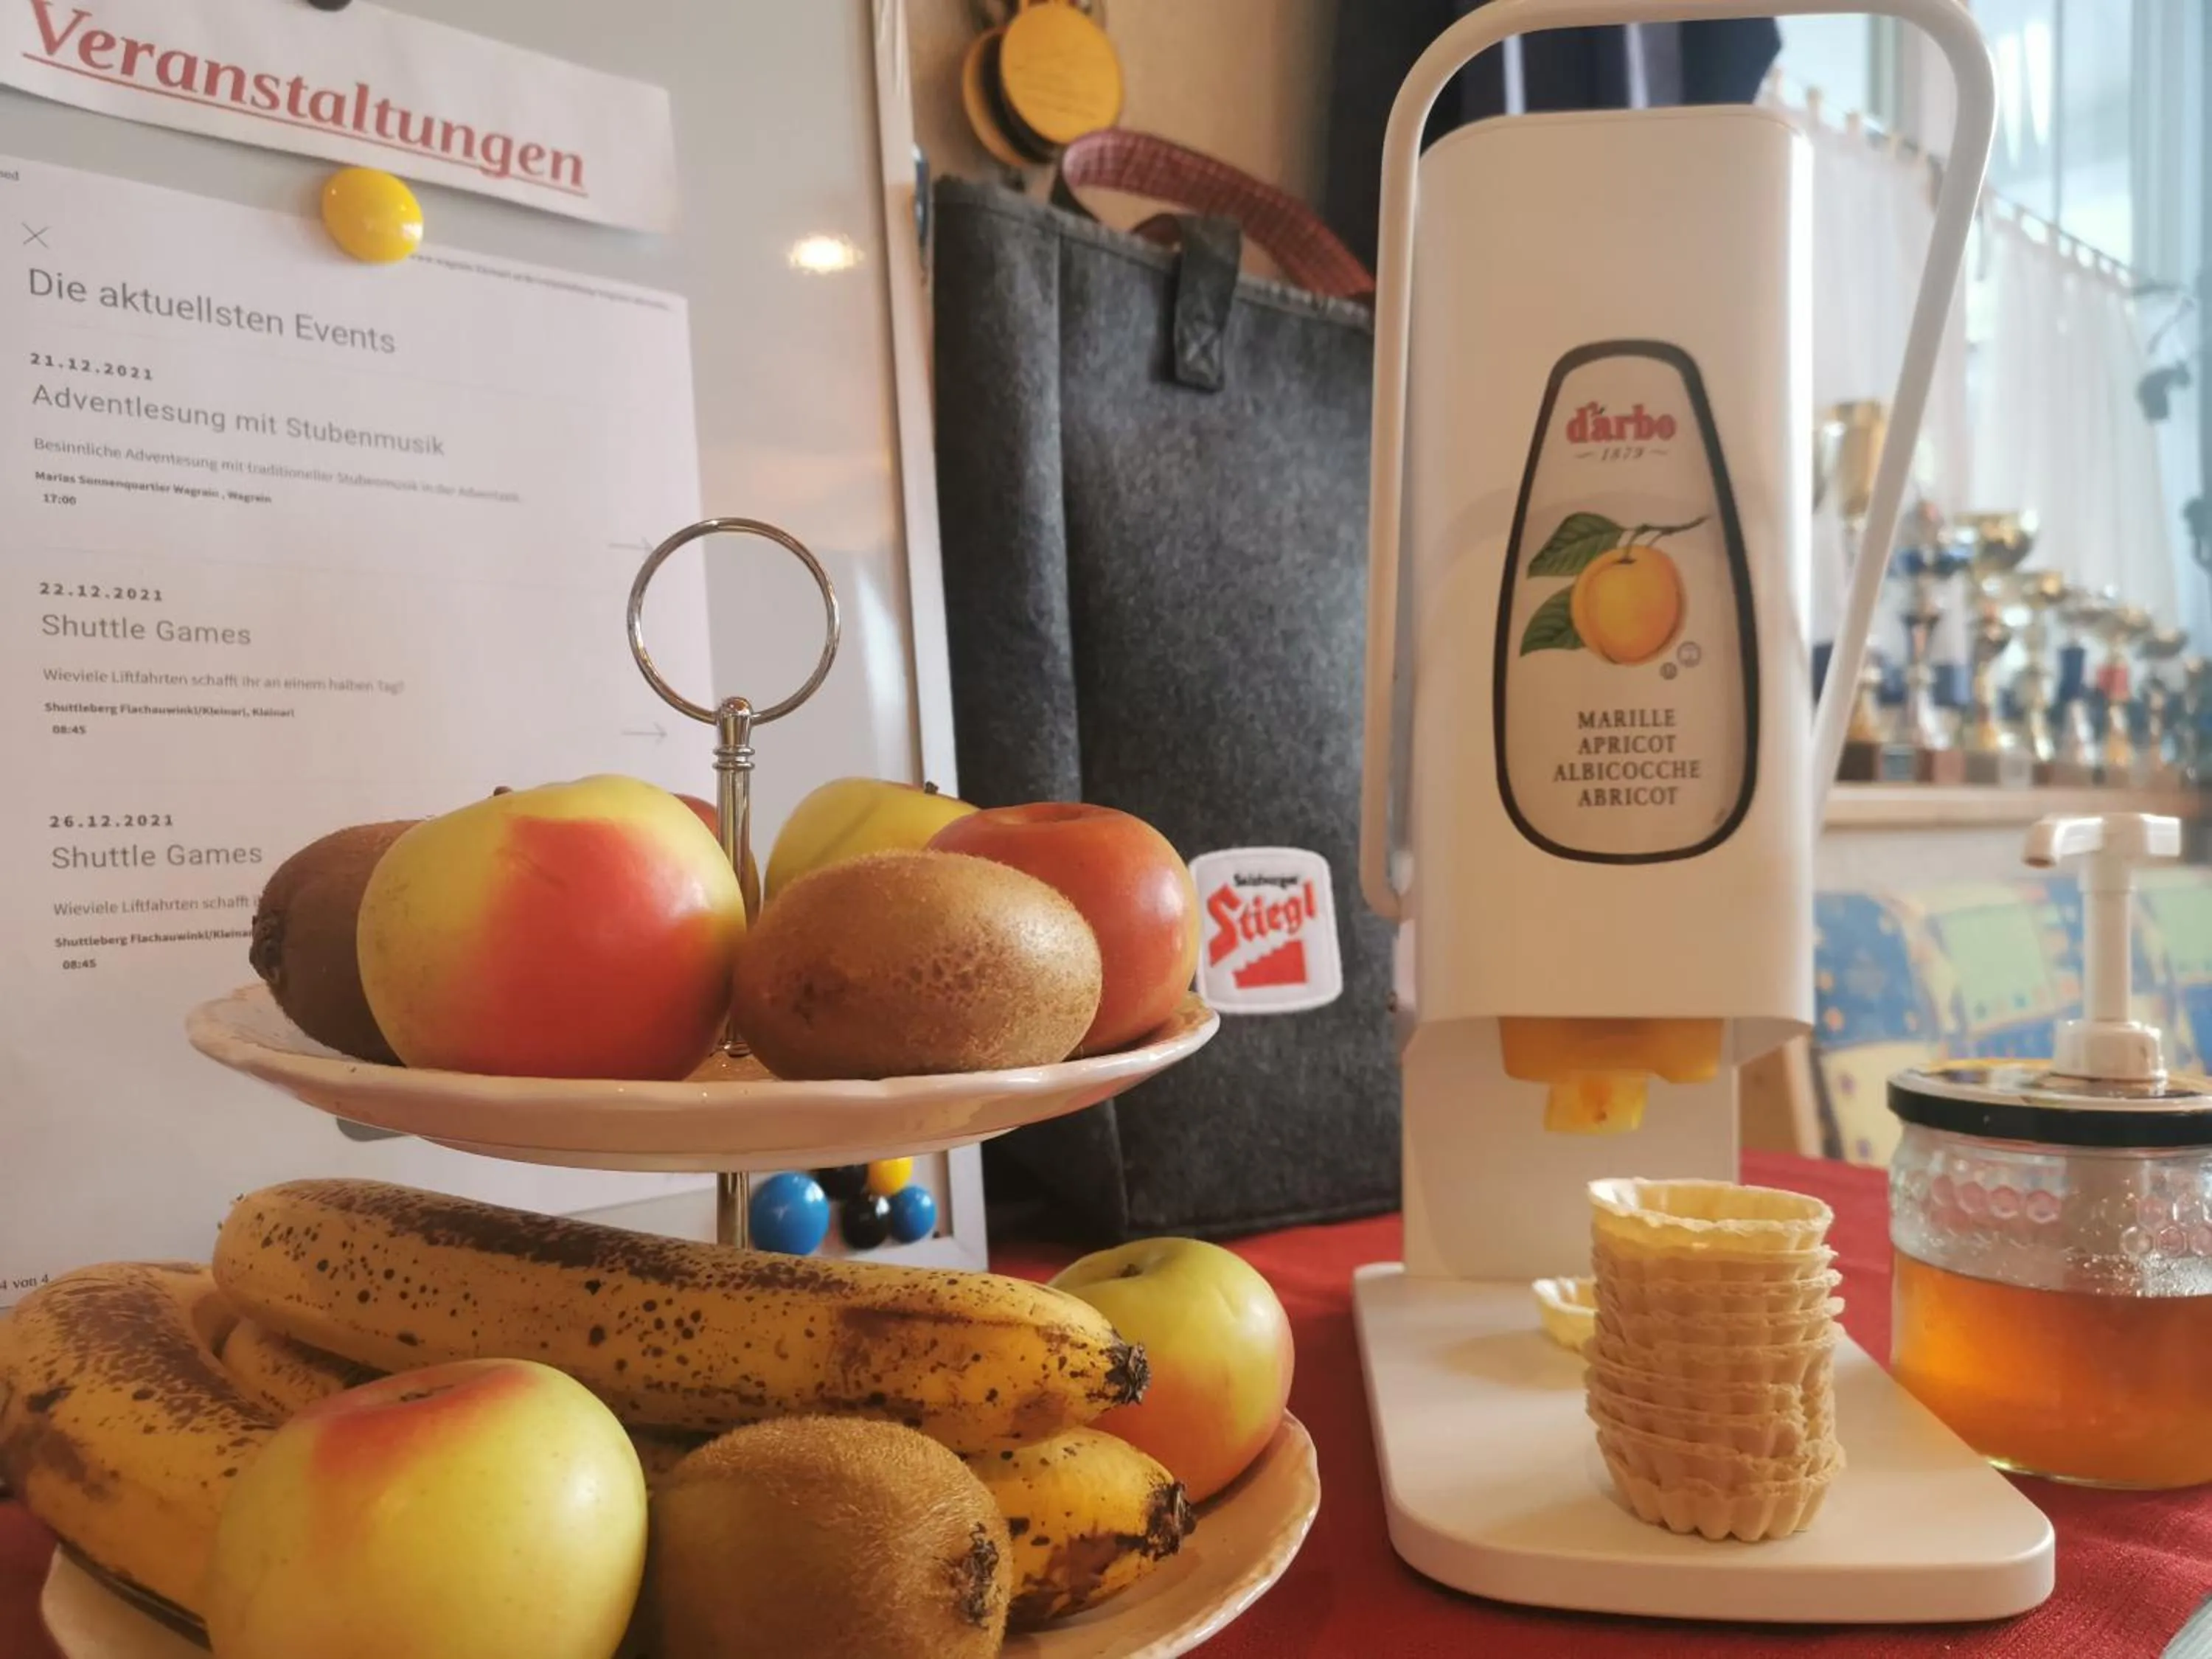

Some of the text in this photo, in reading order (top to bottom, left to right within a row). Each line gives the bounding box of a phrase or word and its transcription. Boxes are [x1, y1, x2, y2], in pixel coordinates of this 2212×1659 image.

[28, 0, 588, 189] Veranstaltungen
[29, 268, 396, 355] Die aktuellsten Events
[30, 352, 153, 380] 21.12.2021
[32, 384, 445, 456] Adventlesung mit Stubenmusik
[34, 437, 122, 459] Besinnliche
[221, 461, 244, 473] mit
[43, 493, 77, 506] 17:00
[78, 475, 170, 493] Sonnenquartier
[173, 484, 220, 498] Wagrain
[227, 491, 272, 504] Wagrain
[39, 582, 163, 602] 22.12.2021
[41, 614, 251, 645] Shuttle Games
[43, 668, 108, 683] Wieviele
[111, 669, 187, 686] Liftfahrten
[191, 674, 238, 688] schafft
[243, 675, 260, 688] ihr
[44, 702, 118, 716] Shuttleberg
[1577, 709, 1676, 730] MARILLE
[52, 725, 86, 734] 08:45
[1577, 734, 1677, 755] APRICOT
[1552, 759, 1702, 782] ALBICOCCHE
[1578, 786, 1679, 807] ABRICOT
[49, 815, 174, 829] 26.12.2021
[52, 844, 263, 869] Shuttle Games
[54, 901, 118, 916] Wieviele
[122, 899, 198, 914] Liftfahrten
[202, 895, 250, 909] schafft
[1207, 880, 1315, 968] Stiegl
[55, 934, 128, 947] Shuttleberg
[62, 959, 97, 970] 08:45
[13, 1278, 36, 1289] von
[41, 1274, 48, 1283] 4
